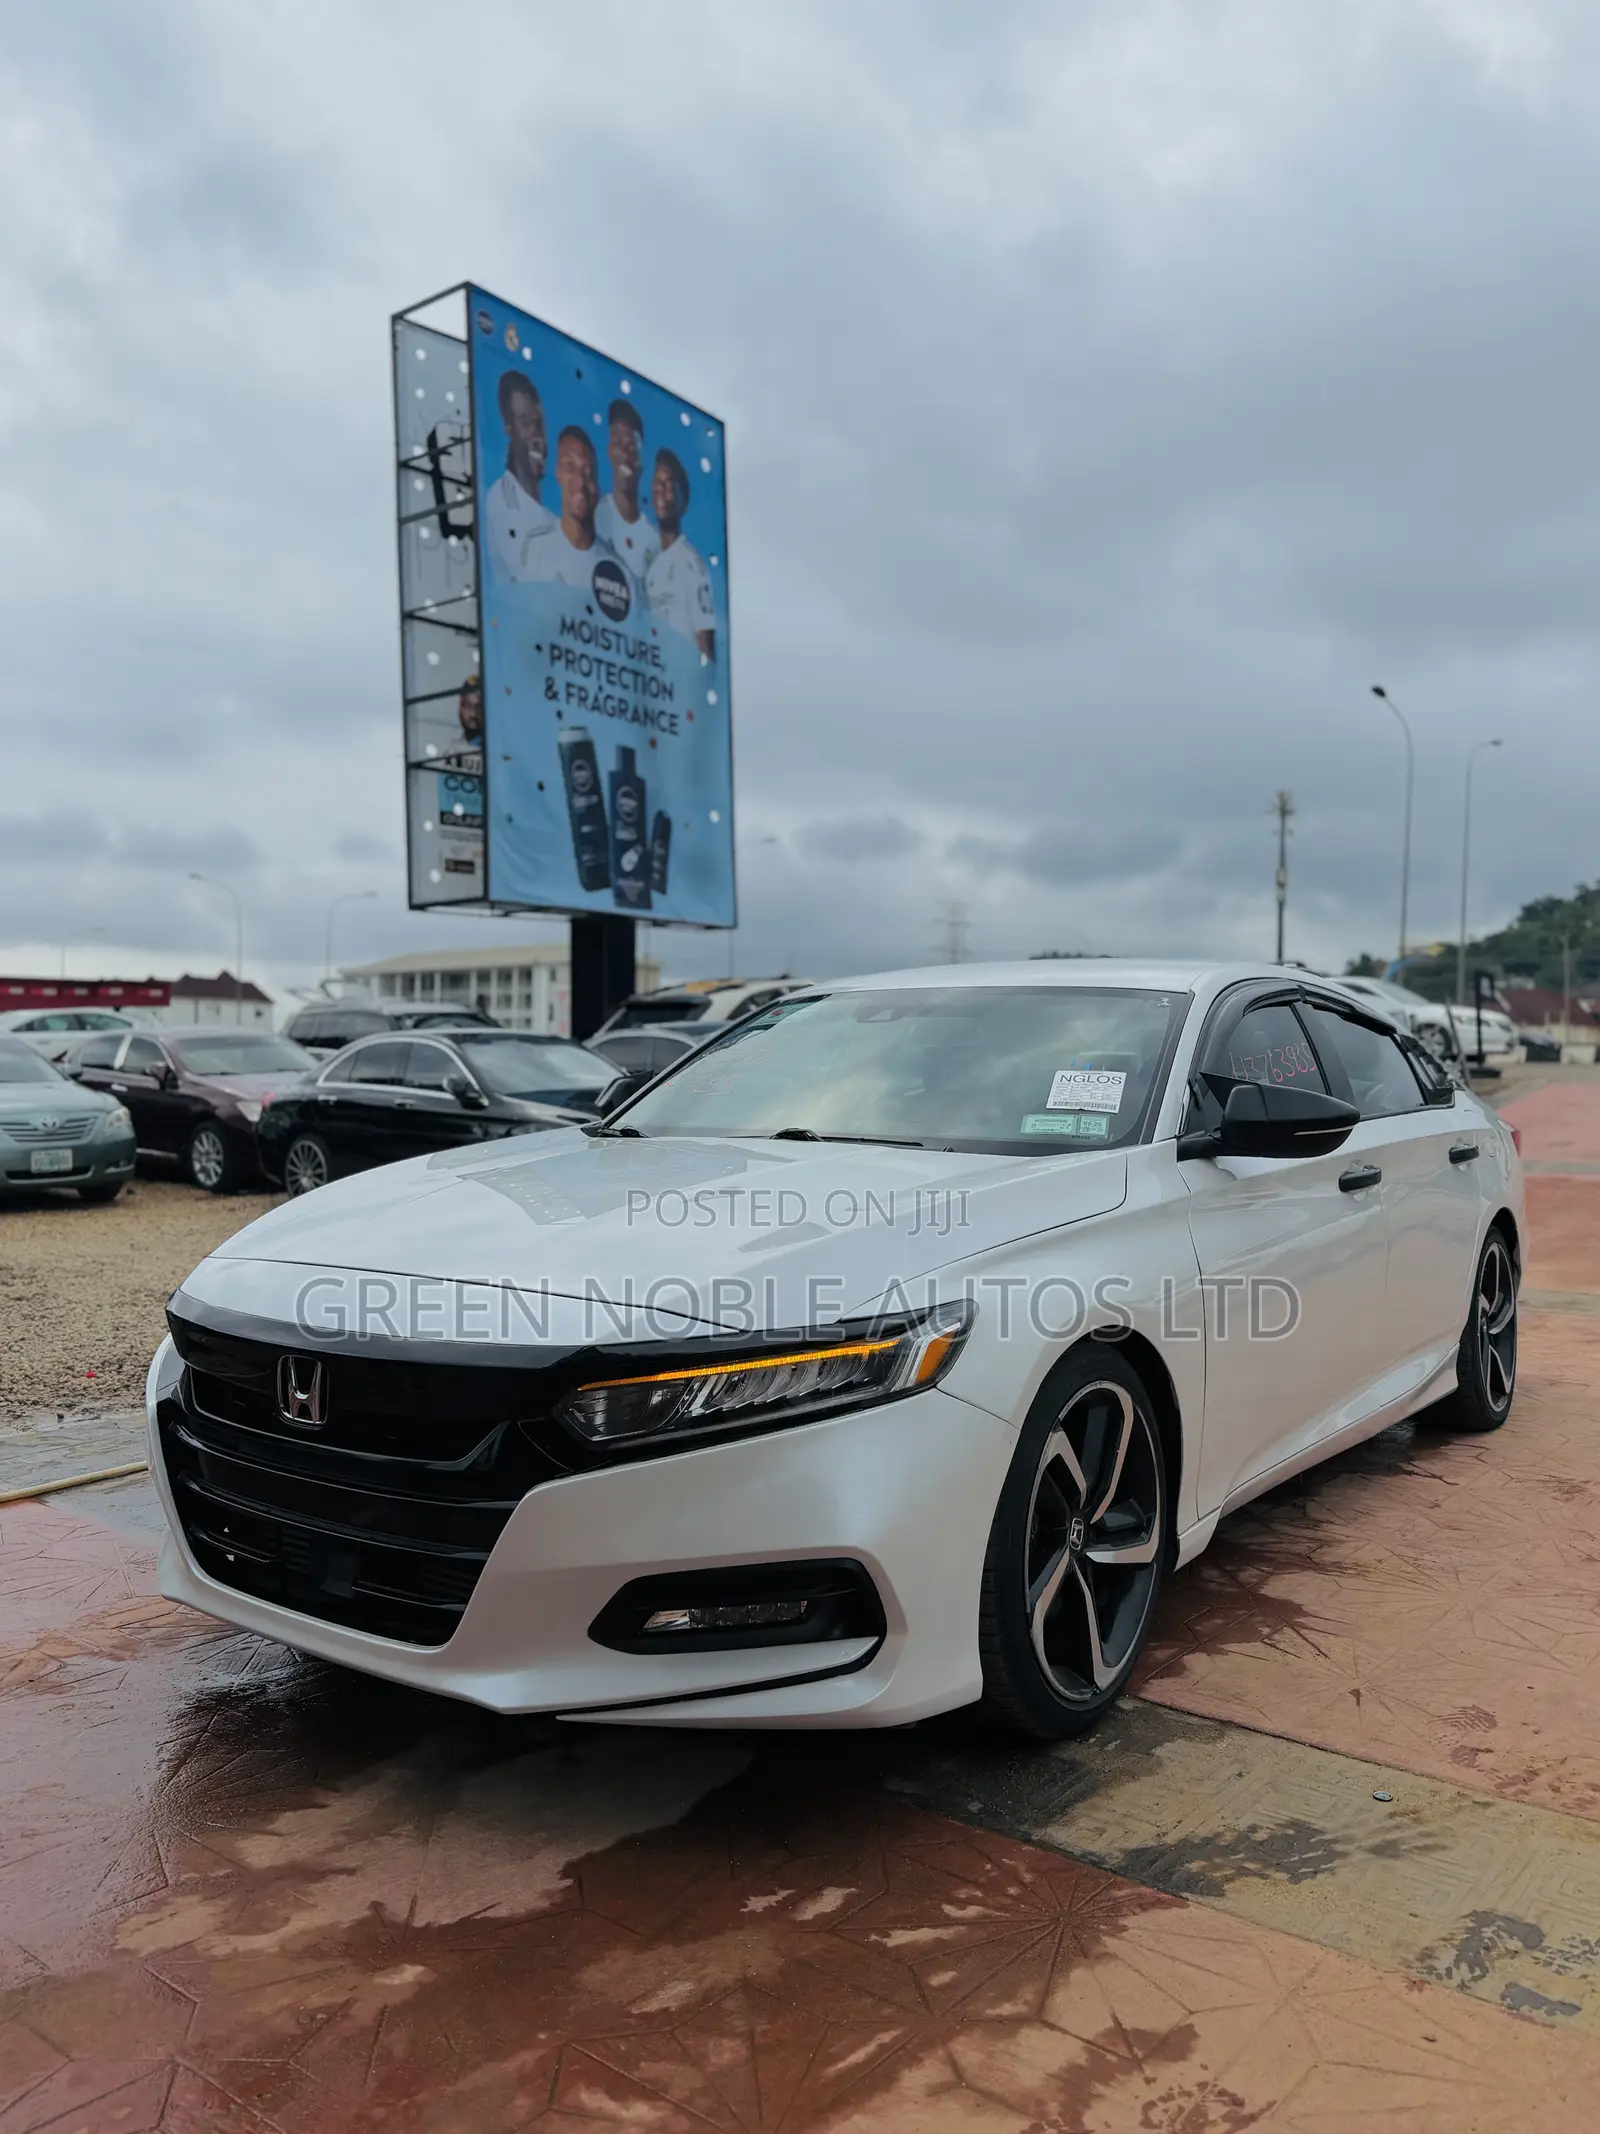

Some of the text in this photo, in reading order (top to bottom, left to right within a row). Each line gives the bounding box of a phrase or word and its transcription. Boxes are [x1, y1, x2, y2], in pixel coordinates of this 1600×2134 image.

[549, 643, 675, 702] PROTECTION
[559, 615, 666, 673] MOISTURE,
[544, 676, 680, 735] & FRAGRANCE
[1059, 1074, 1122, 1085] NGLOS
